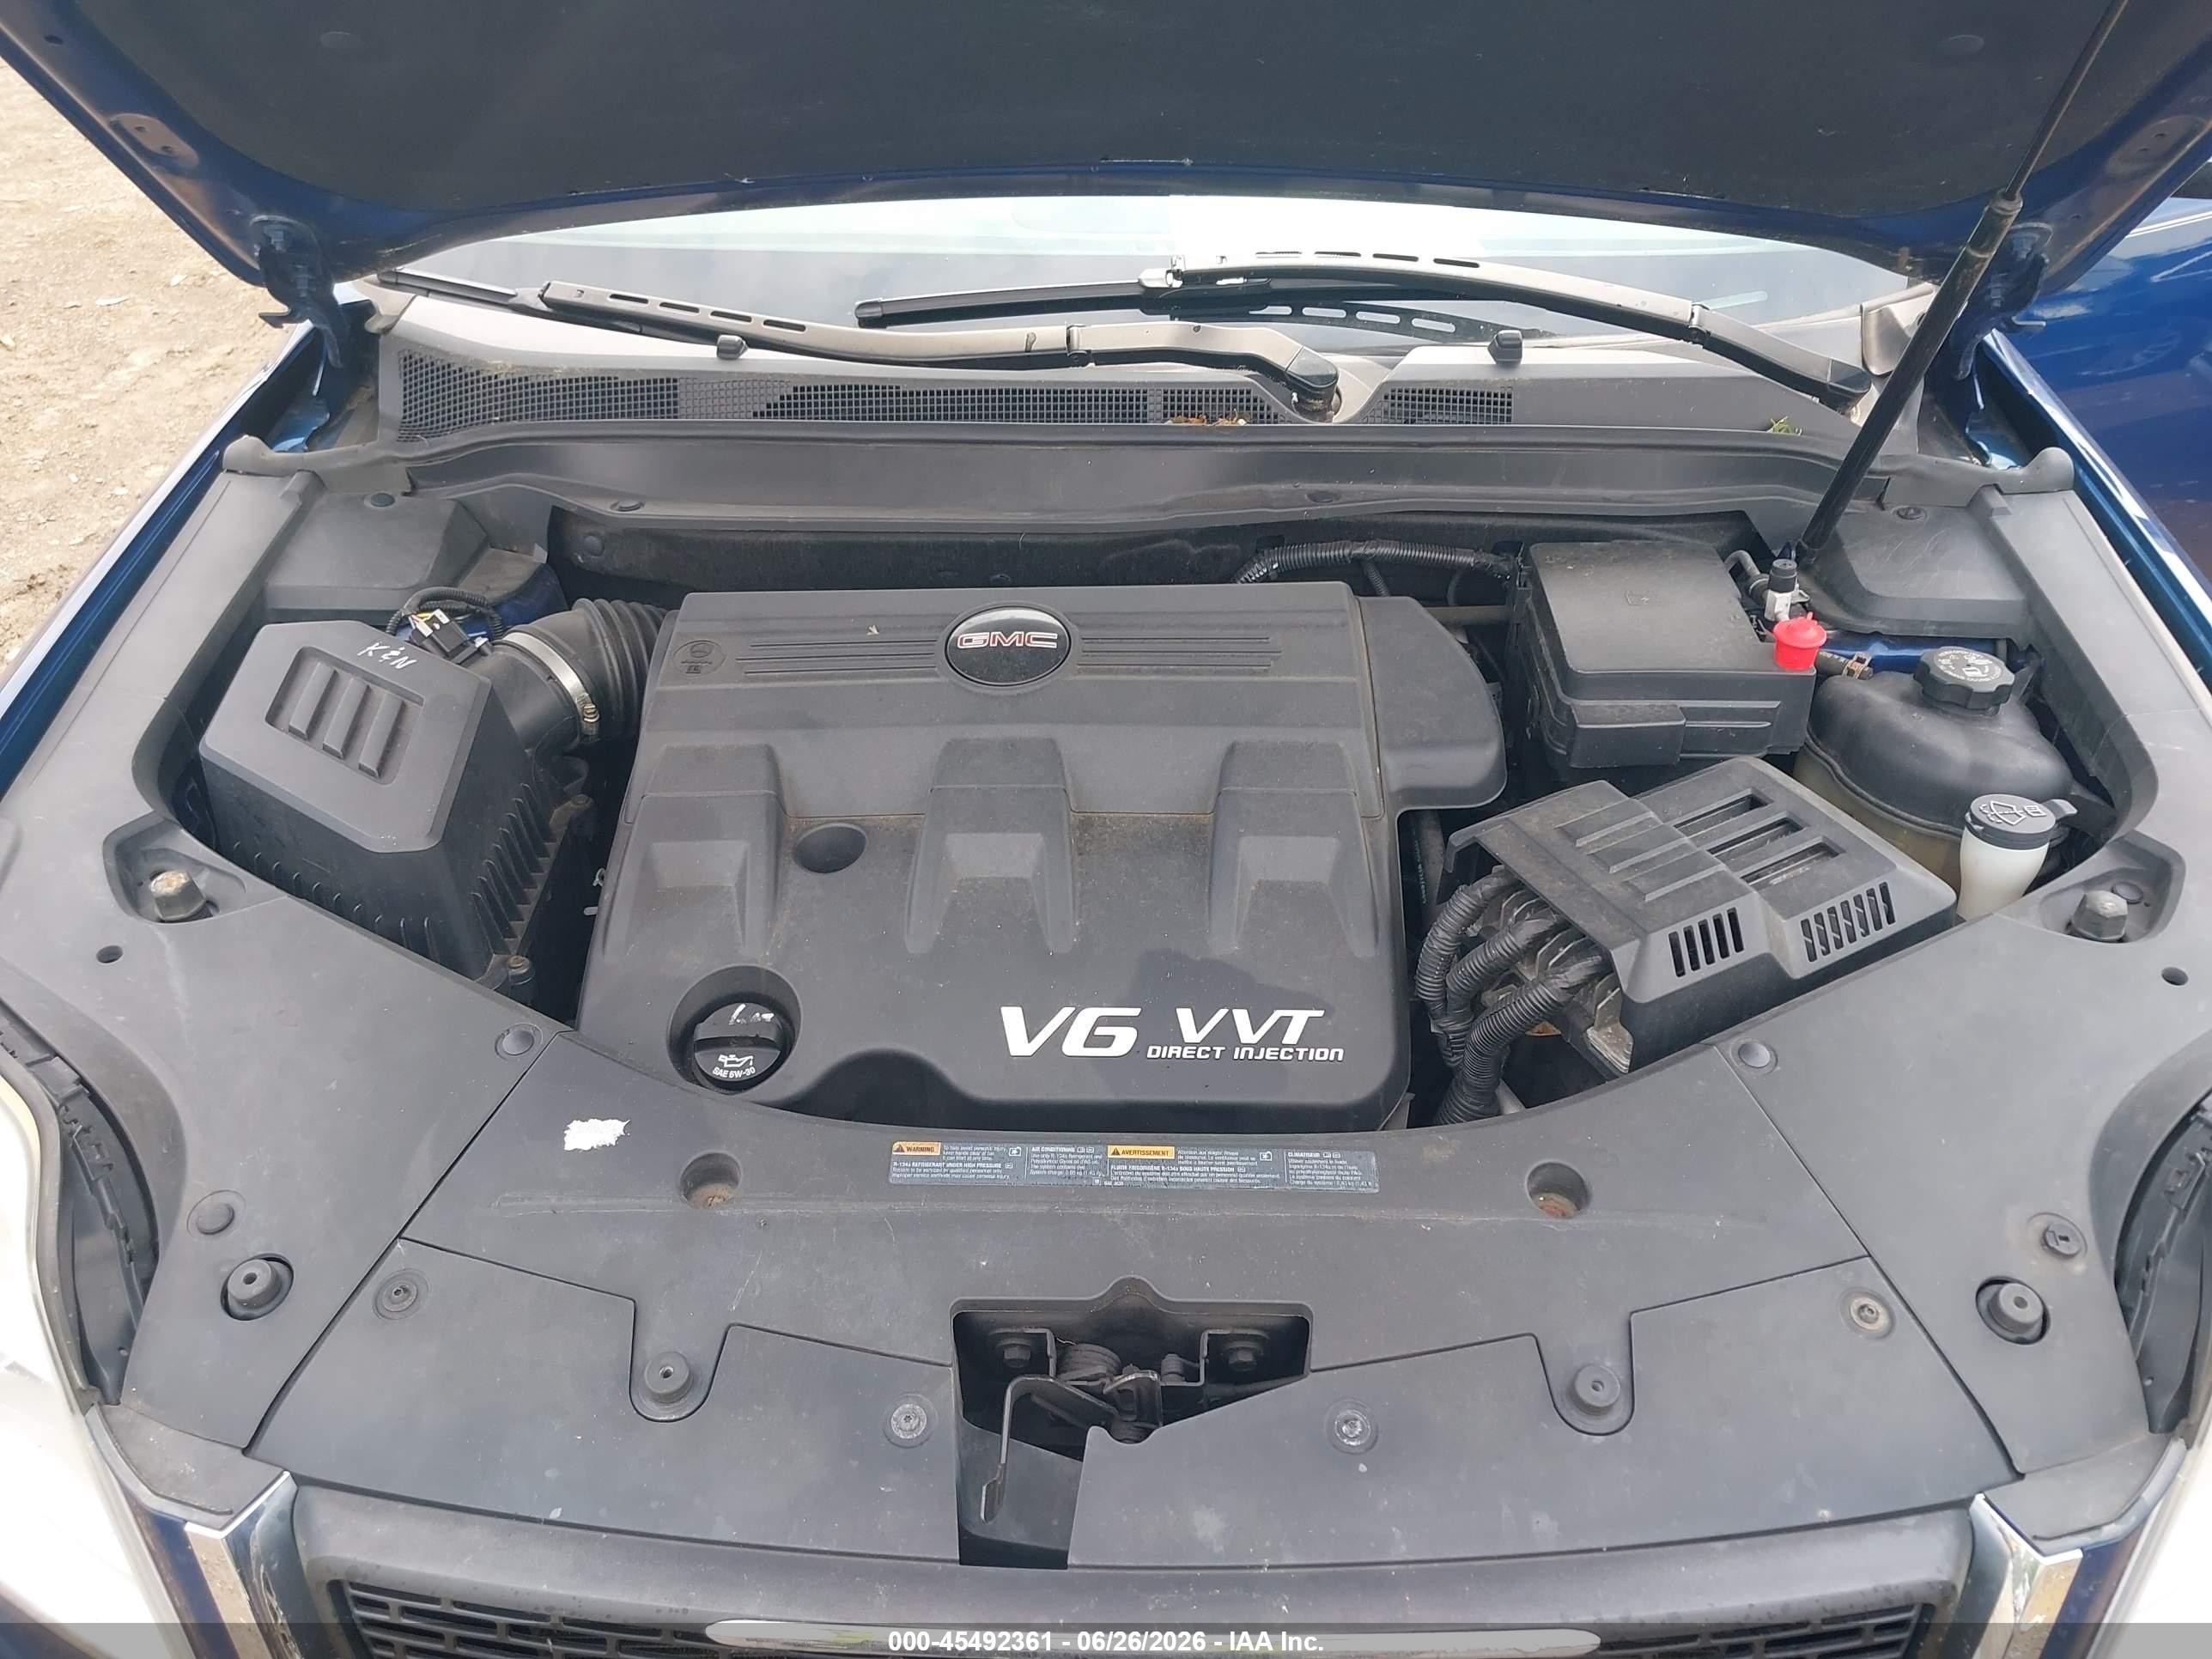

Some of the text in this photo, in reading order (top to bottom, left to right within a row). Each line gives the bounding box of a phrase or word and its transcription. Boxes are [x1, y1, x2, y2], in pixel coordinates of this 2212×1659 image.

[957, 631, 1058, 648] GMC
[1000, 1006, 1325, 1057] V6 VVT
[1146, 1045, 1345, 1061] DIRECT INJECTION
[712, 1066, 729, 1078] SAE
